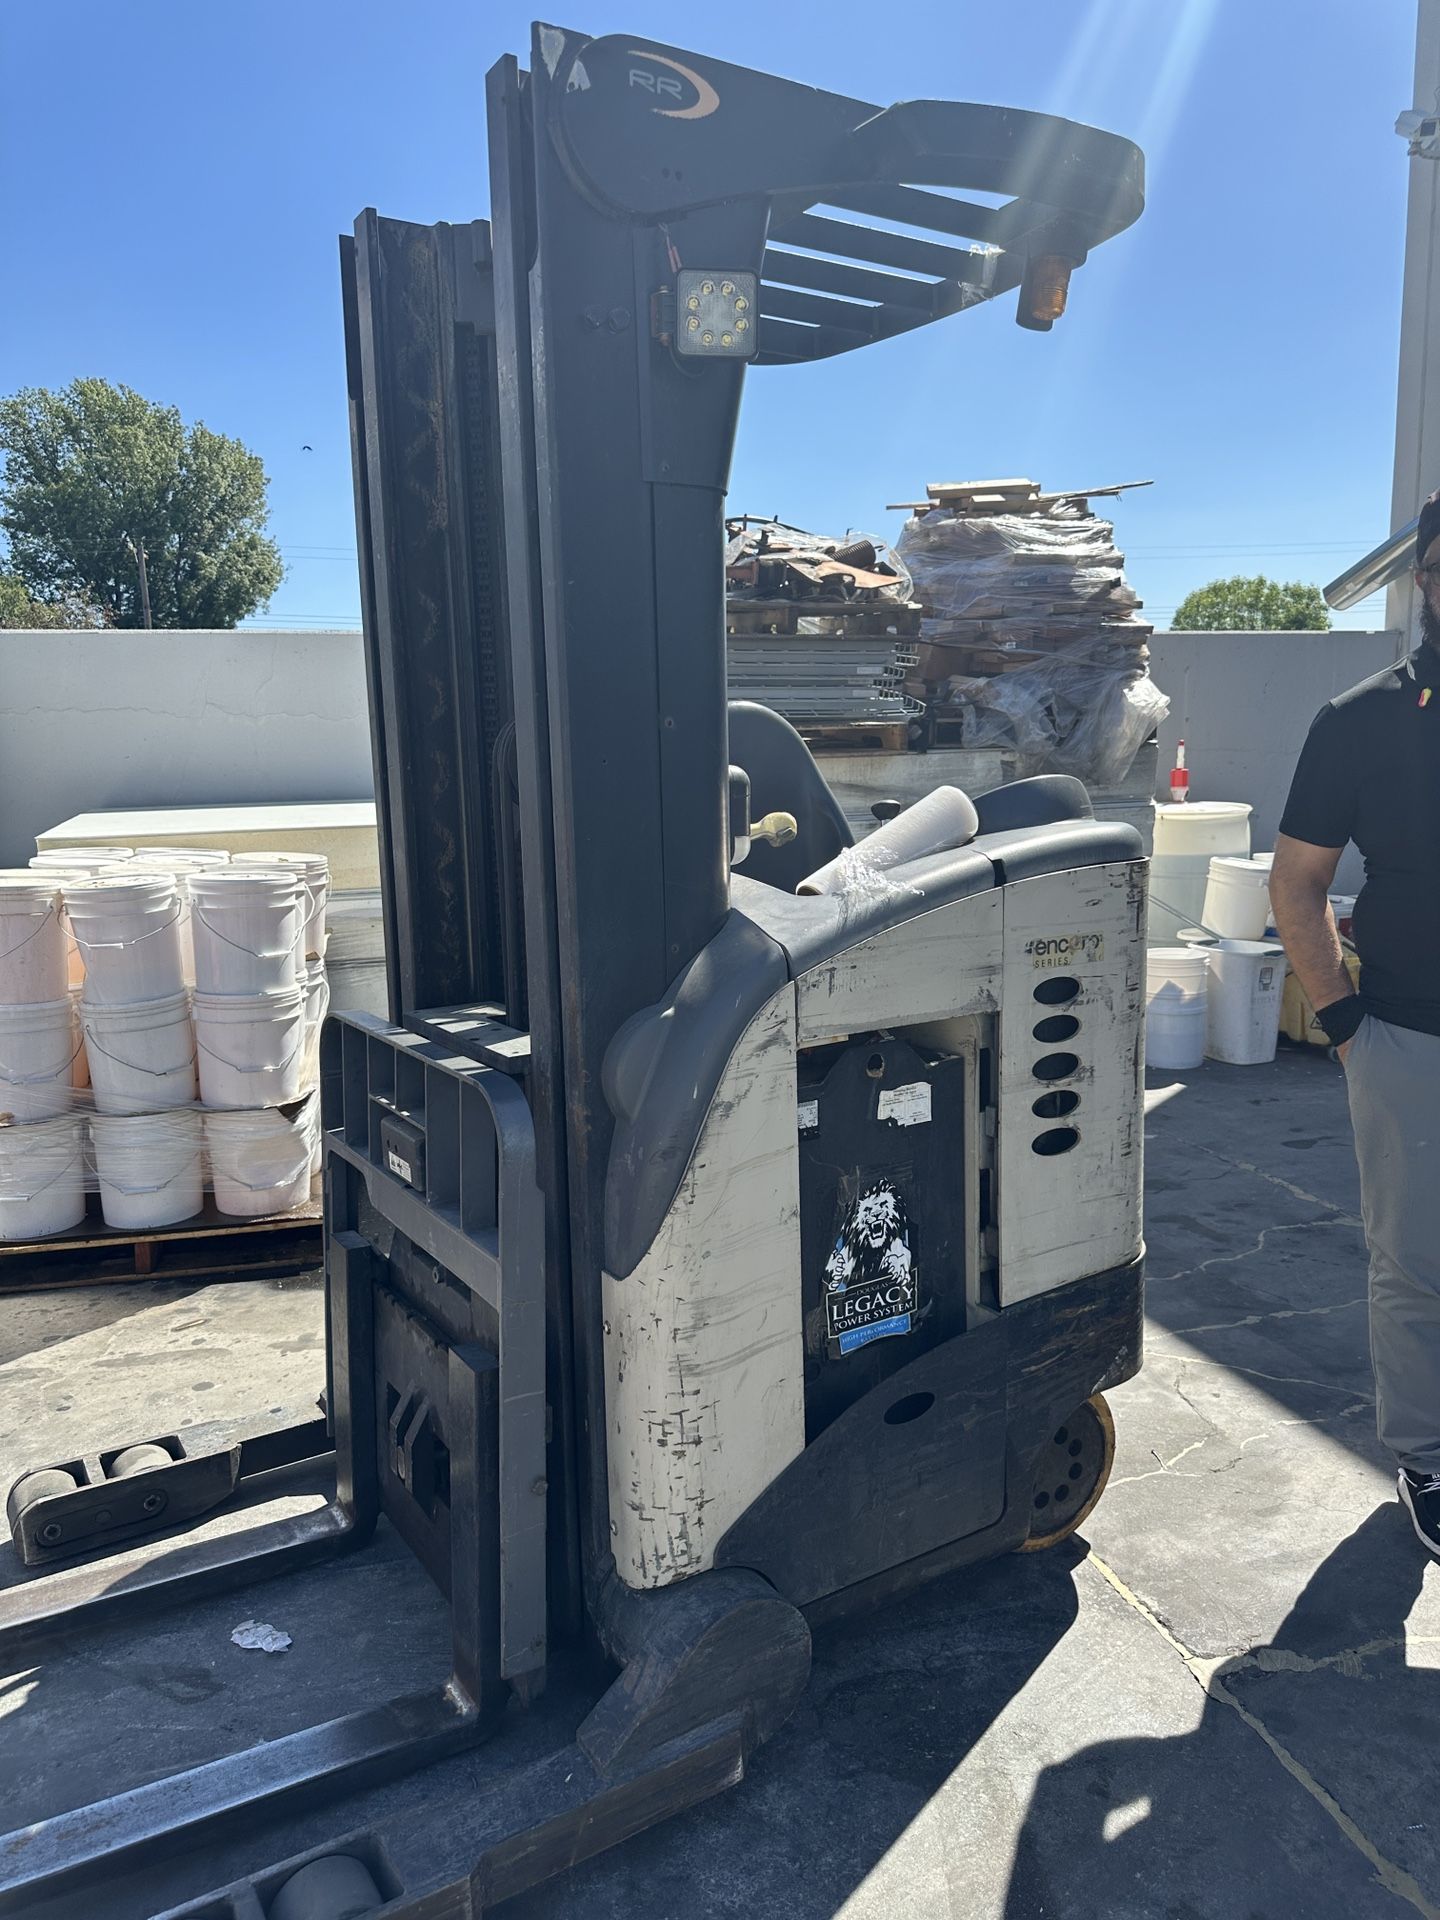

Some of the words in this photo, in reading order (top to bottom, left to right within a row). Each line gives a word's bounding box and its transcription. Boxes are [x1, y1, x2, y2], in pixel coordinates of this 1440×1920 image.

[629, 69, 682, 100] RR
[1034, 956, 1070, 969] SERIES
[832, 1286, 914, 1320] LEGACY
[833, 1313, 871, 1332] POWER
[873, 1301, 913, 1319] SYSTEM
